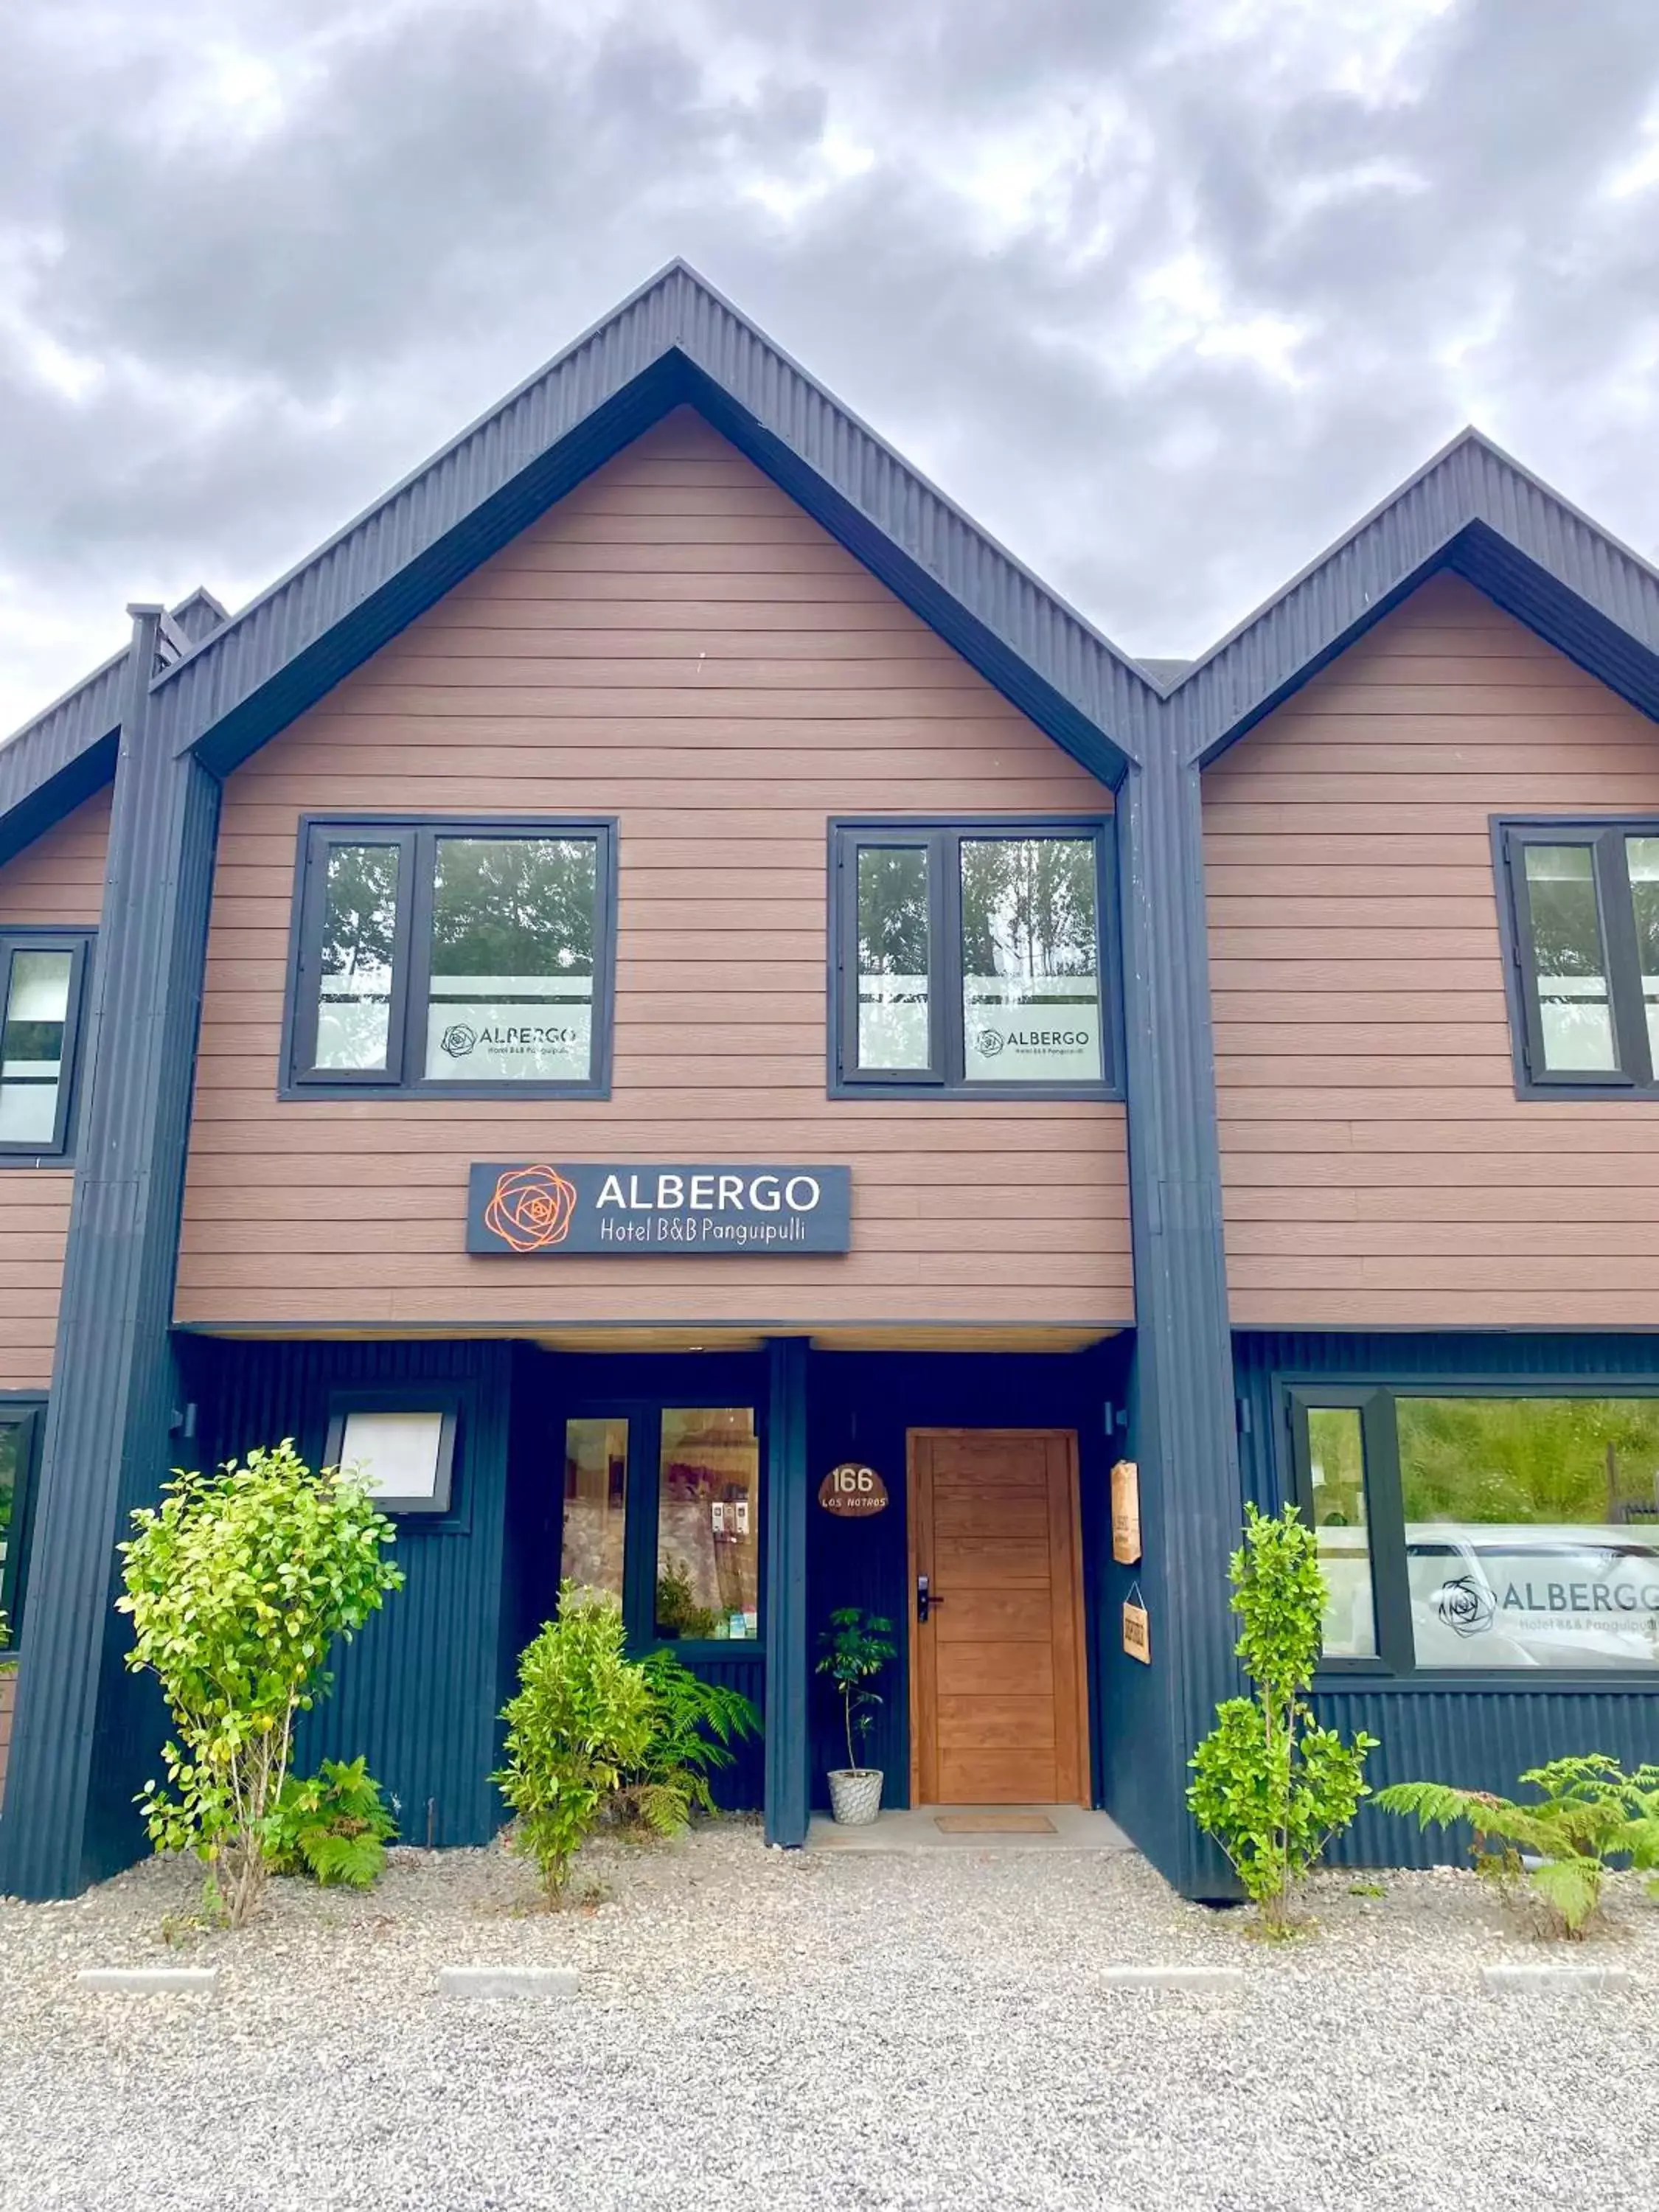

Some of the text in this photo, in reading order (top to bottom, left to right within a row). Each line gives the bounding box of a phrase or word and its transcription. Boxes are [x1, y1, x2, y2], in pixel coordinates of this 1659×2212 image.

[1007, 1032, 1089, 1045] ALBERGO
[595, 1175, 821, 1211] ALBERGO
[601, 1217, 805, 1245] Hotel B&B Panguipulli
[832, 1468, 874, 1493] 166
